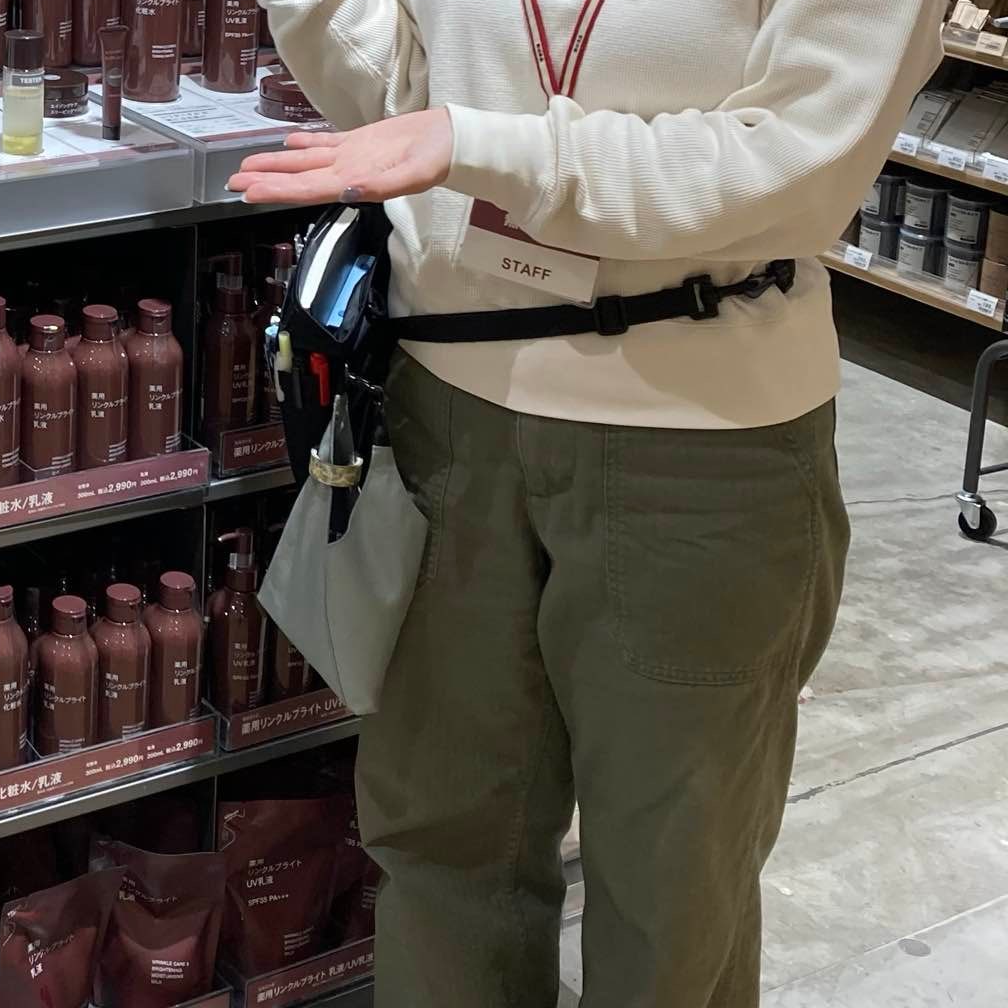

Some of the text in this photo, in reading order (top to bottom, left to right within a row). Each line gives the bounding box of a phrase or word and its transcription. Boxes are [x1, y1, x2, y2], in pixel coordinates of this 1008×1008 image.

[501, 257, 552, 281] STAFF
[149, 384, 163, 392] 薬用
[148, 402, 163, 410] 乳液
[91, 410, 105, 418] 乳液
[33, 420, 48, 429] 乳液
[242, 705, 322, 735] 薬用リンクルブライト
[248, 859, 302, 876] リンクルブライト
[246, 875, 274, 888] UV乳液
[256, 970, 327, 1003] 薬用リンクルブライト
